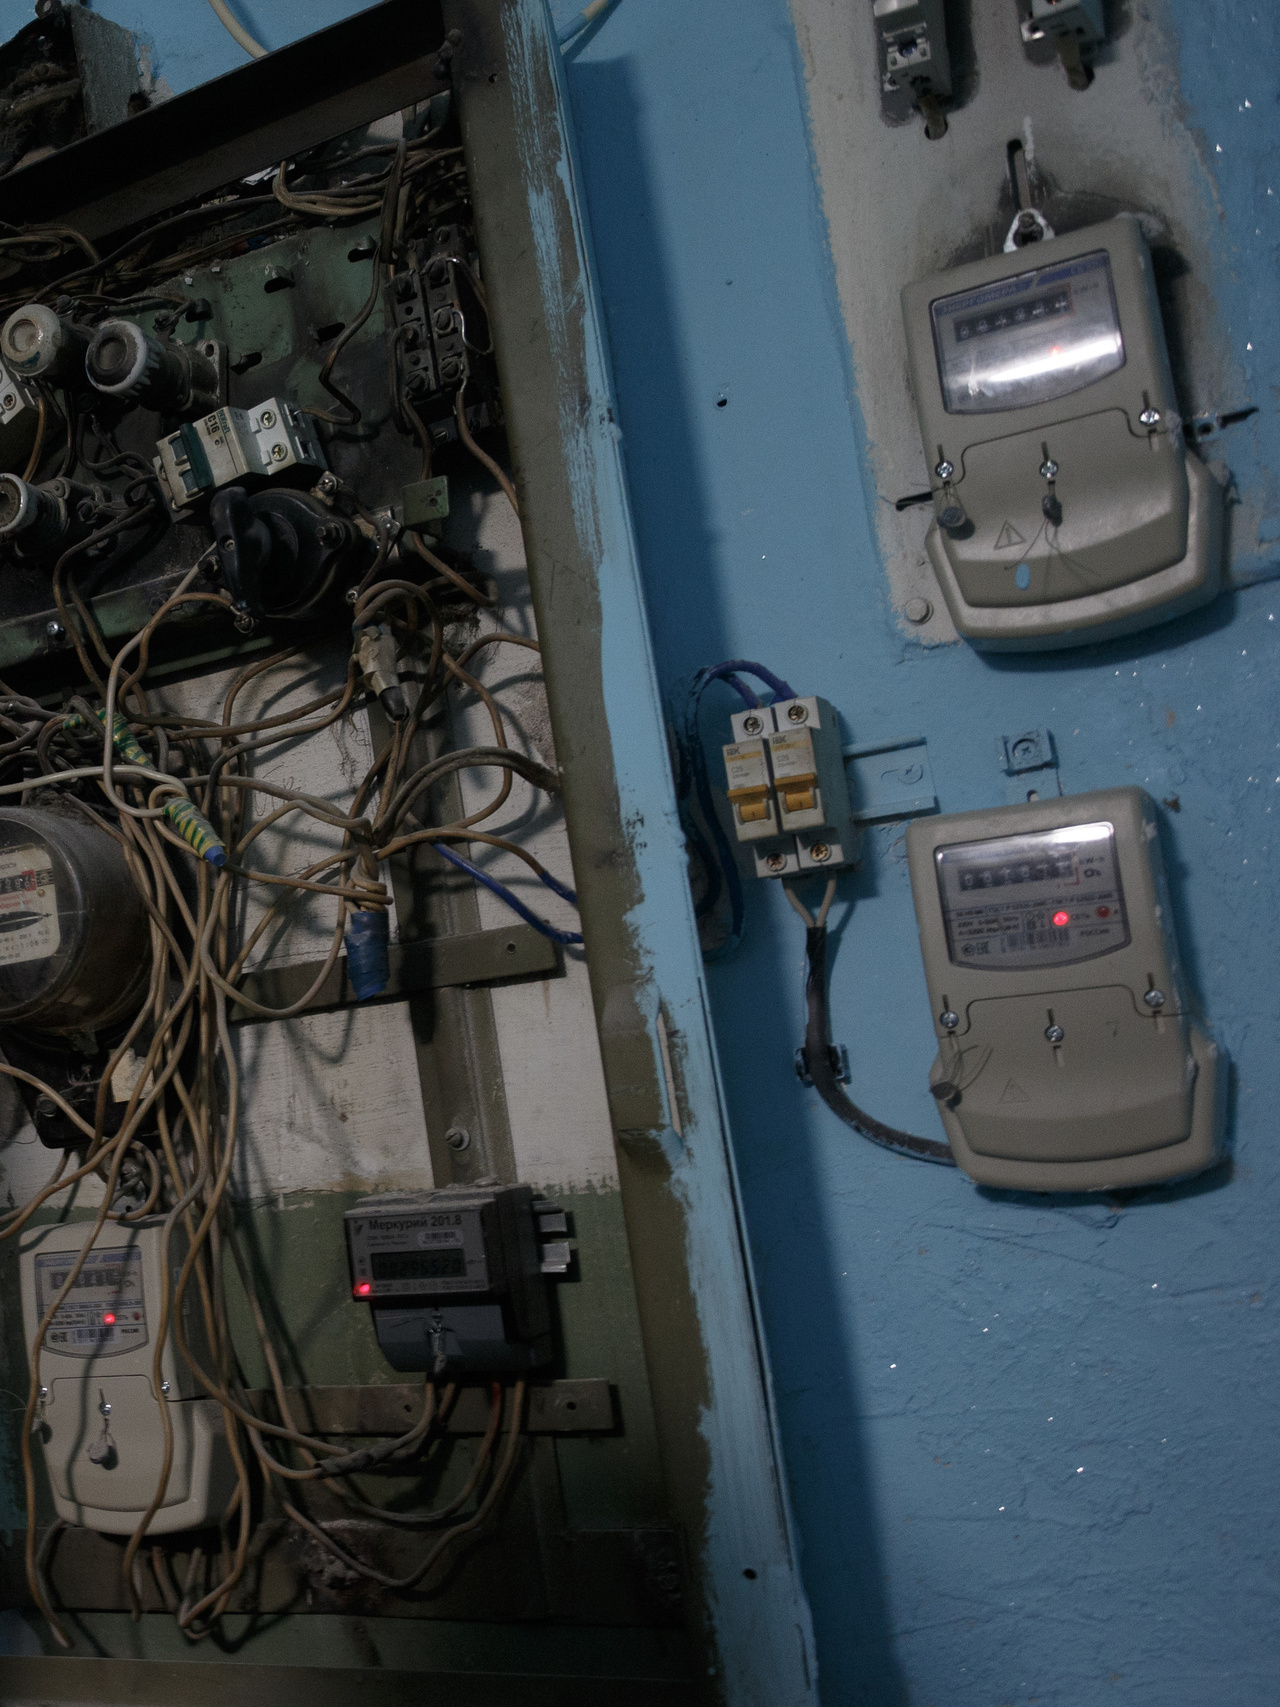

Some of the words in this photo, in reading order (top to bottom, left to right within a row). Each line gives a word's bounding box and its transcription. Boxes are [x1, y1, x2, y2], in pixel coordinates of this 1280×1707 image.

[208, 415, 220, 433] C16
[369, 1217, 428, 1231] Меркурий
[431, 1215, 463, 1227] 201.8
